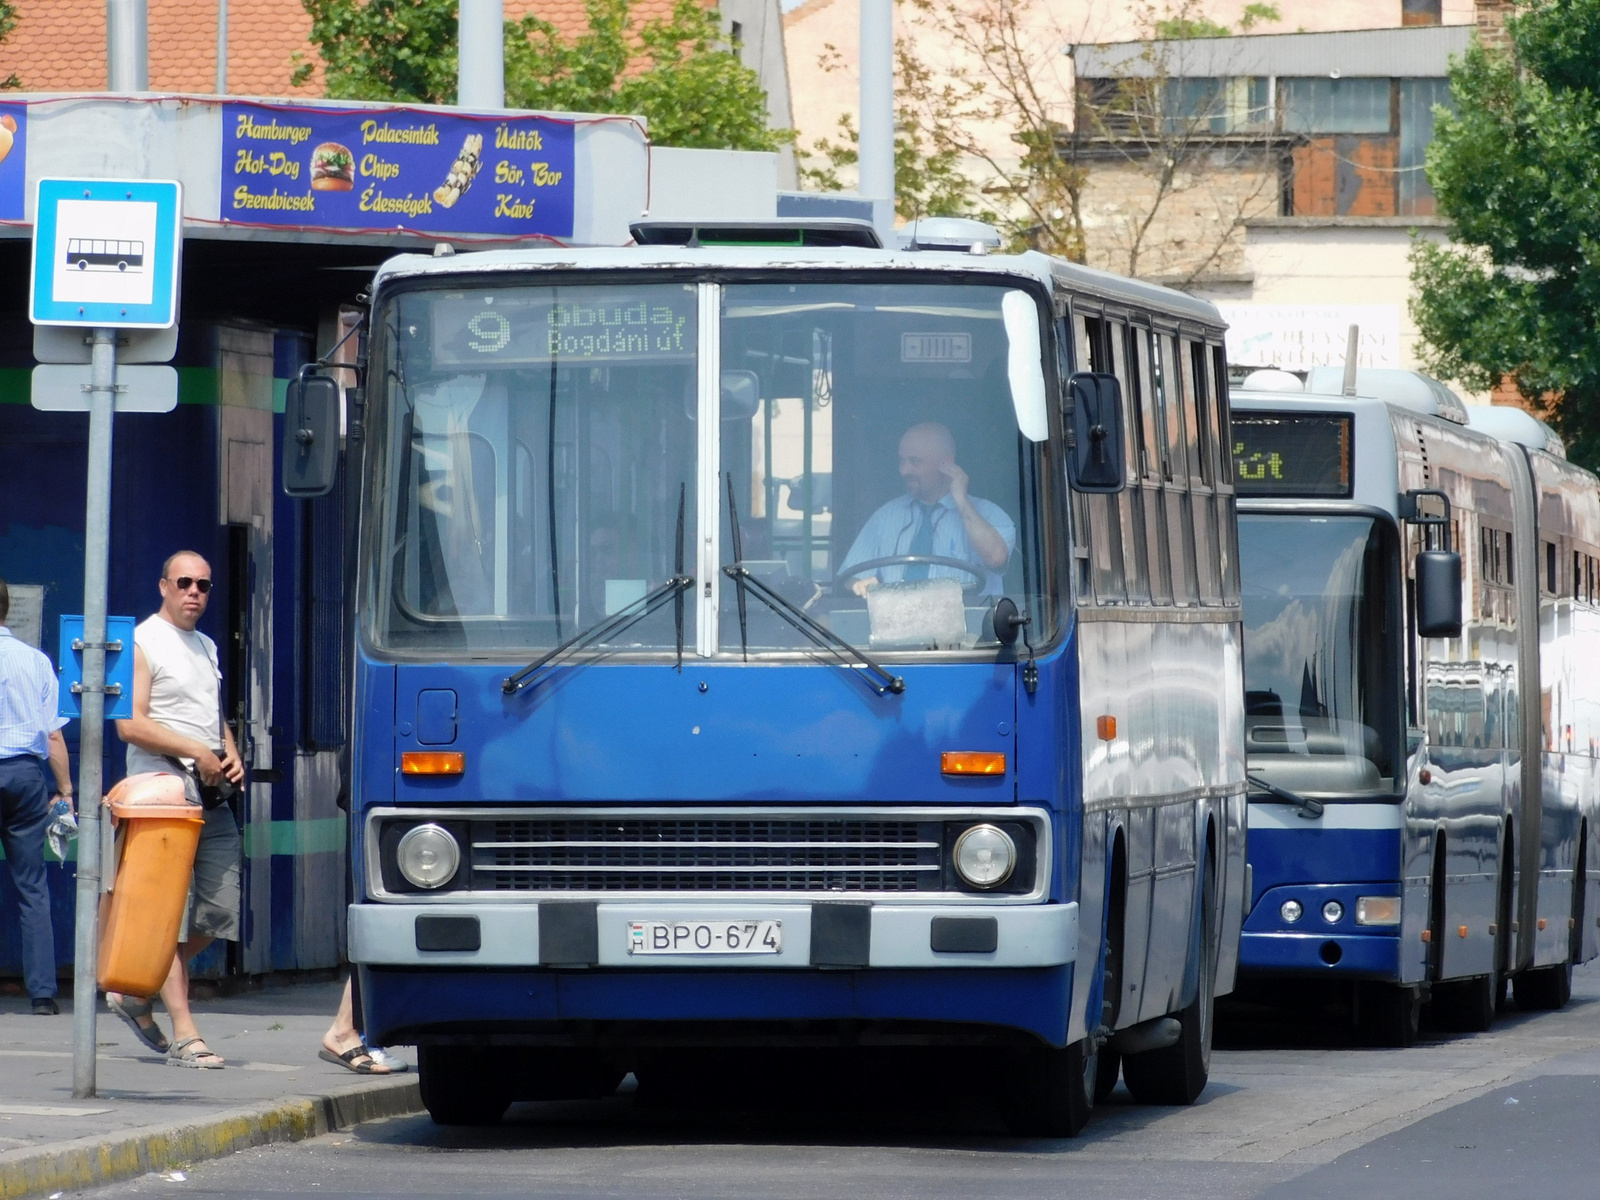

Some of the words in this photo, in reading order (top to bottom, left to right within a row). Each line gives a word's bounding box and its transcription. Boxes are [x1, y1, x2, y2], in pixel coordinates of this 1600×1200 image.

[235, 114, 313, 146] Hamburger
[360, 119, 440, 146] Palacsinták
[495, 121, 543, 151] Üdítők
[234, 149, 301, 181] Hot-Dog
[360, 153, 400, 182] Chips
[494, 160, 525, 188] Sör,
[530, 162, 562, 187] Bor
[233, 185, 316, 212] Szendvicsek
[359, 182, 433, 219] Édességek
[494, 193, 536, 219] Kávé
[467, 310, 511, 353] 9
[548, 328, 648, 356] Bogdáni
[656, 326, 685, 353] út
[1239, 452, 1283, 479] út
[653, 924, 777, 950] BPO-674
